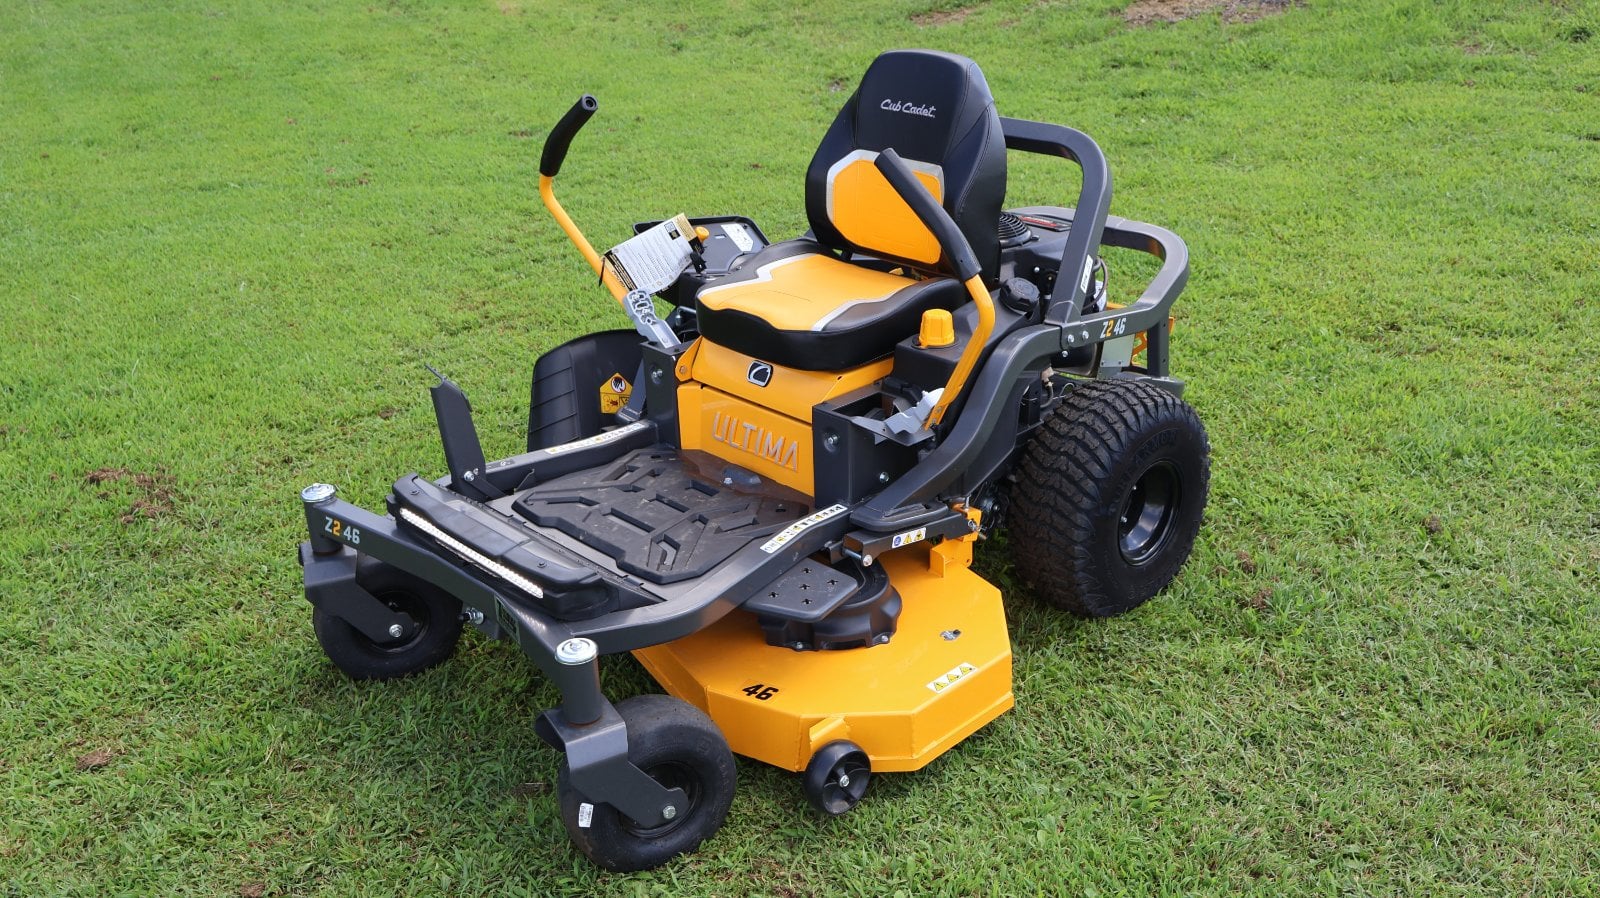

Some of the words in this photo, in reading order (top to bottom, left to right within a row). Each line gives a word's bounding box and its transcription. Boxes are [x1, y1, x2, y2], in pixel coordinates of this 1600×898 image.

[880, 98, 902, 112] Cub
[902, 102, 937, 118] Cadet
[1100, 319, 1115, 339] Z2
[1114, 317, 1127, 336] 46
[712, 411, 798, 473] ULTIMA
[324, 516, 341, 537] Z2
[343, 525, 361, 545] 46
[742, 684, 779, 701] 46
